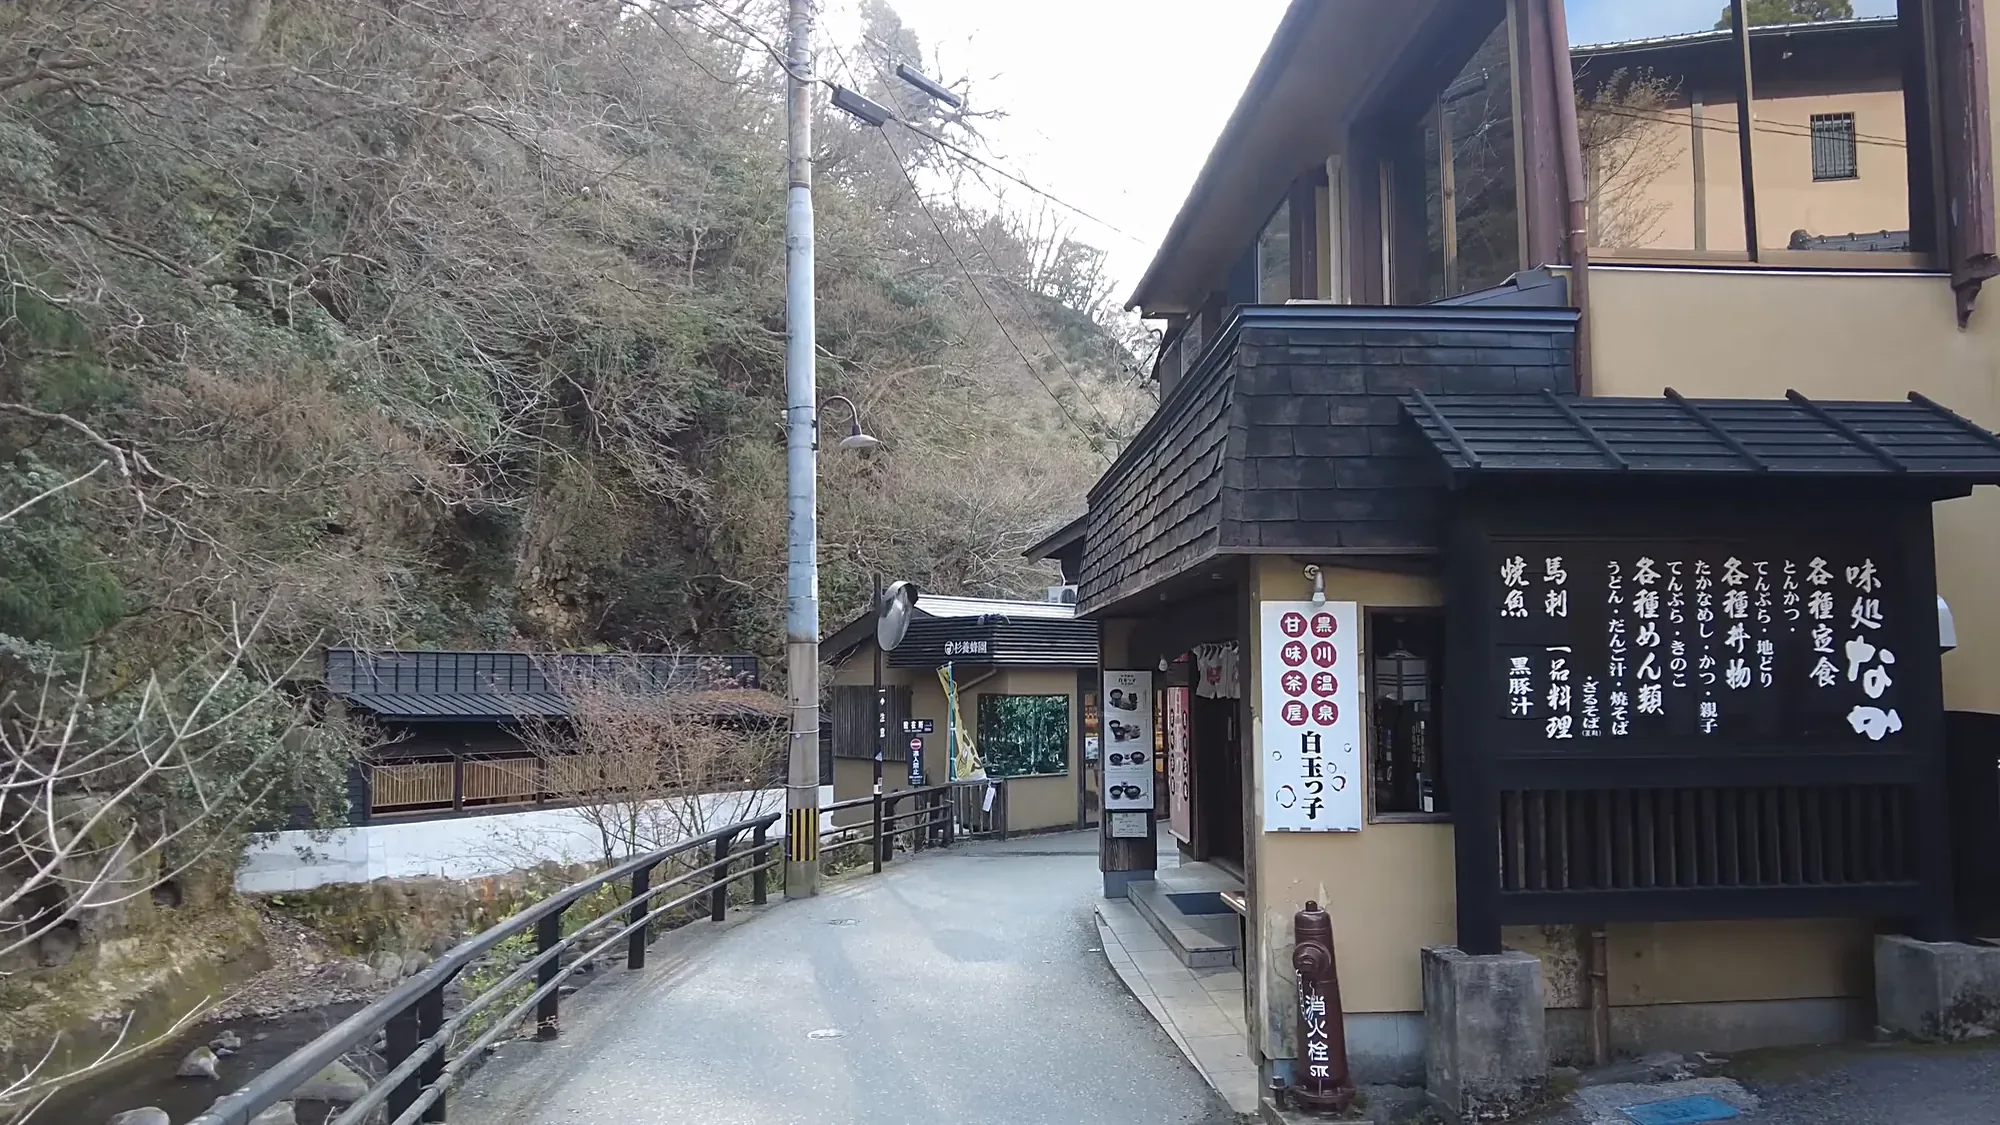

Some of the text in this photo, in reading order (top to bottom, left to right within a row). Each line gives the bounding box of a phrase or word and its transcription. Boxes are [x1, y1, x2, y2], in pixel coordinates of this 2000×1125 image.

[1500, 555, 1530, 618] 焼魚
[1543, 556, 1569, 618] 馬刺
[1721, 556, 1752, 690] 各種丼物
[1806, 556, 1840, 688] 各種定食
[1284, 616, 1304, 722] 甘味茶屋
[1315, 616, 1335, 722] 黒川温泉
[1632, 556, 1665, 716] 各種めん類
[1508, 656, 1534, 716] 黒豚汁
[1545, 645, 1573, 739] 一品料理
[1301, 731, 1325, 820] 白玉っ子
[1305, 995, 1329, 1062] 消火栓
